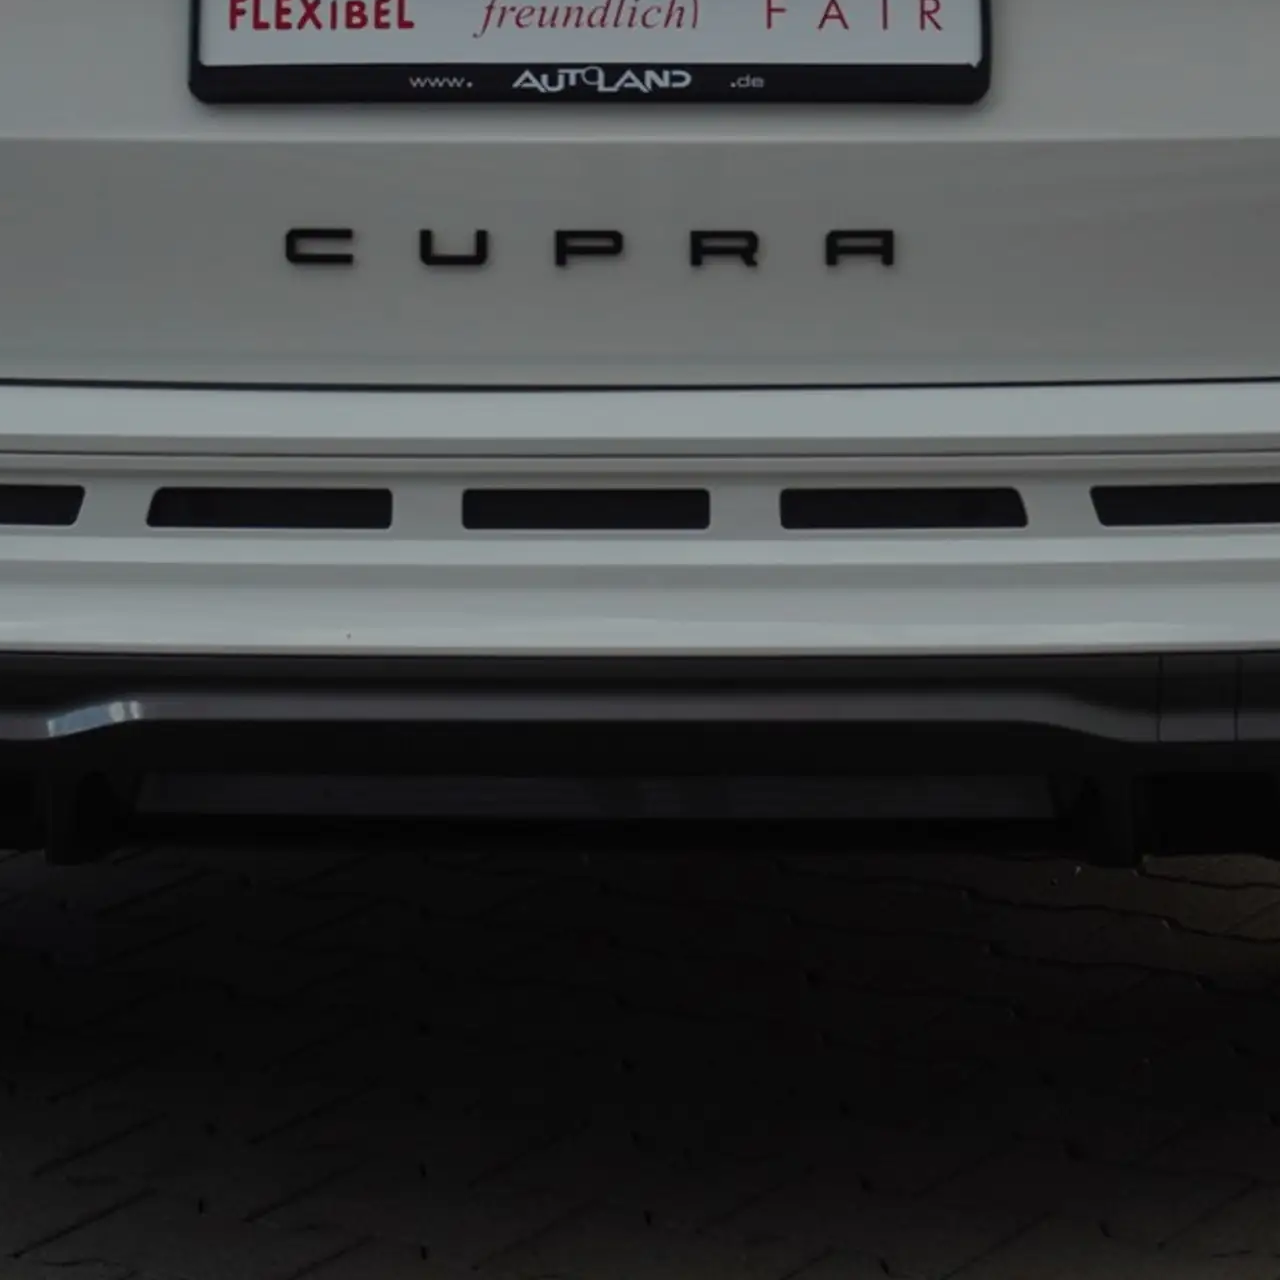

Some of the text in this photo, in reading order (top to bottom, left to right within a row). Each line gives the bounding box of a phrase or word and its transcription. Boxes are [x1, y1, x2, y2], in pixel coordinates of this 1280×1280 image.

[409, 65, 765, 94] www. AUTOLAND .de
[285, 228, 896, 269] CUPRA
